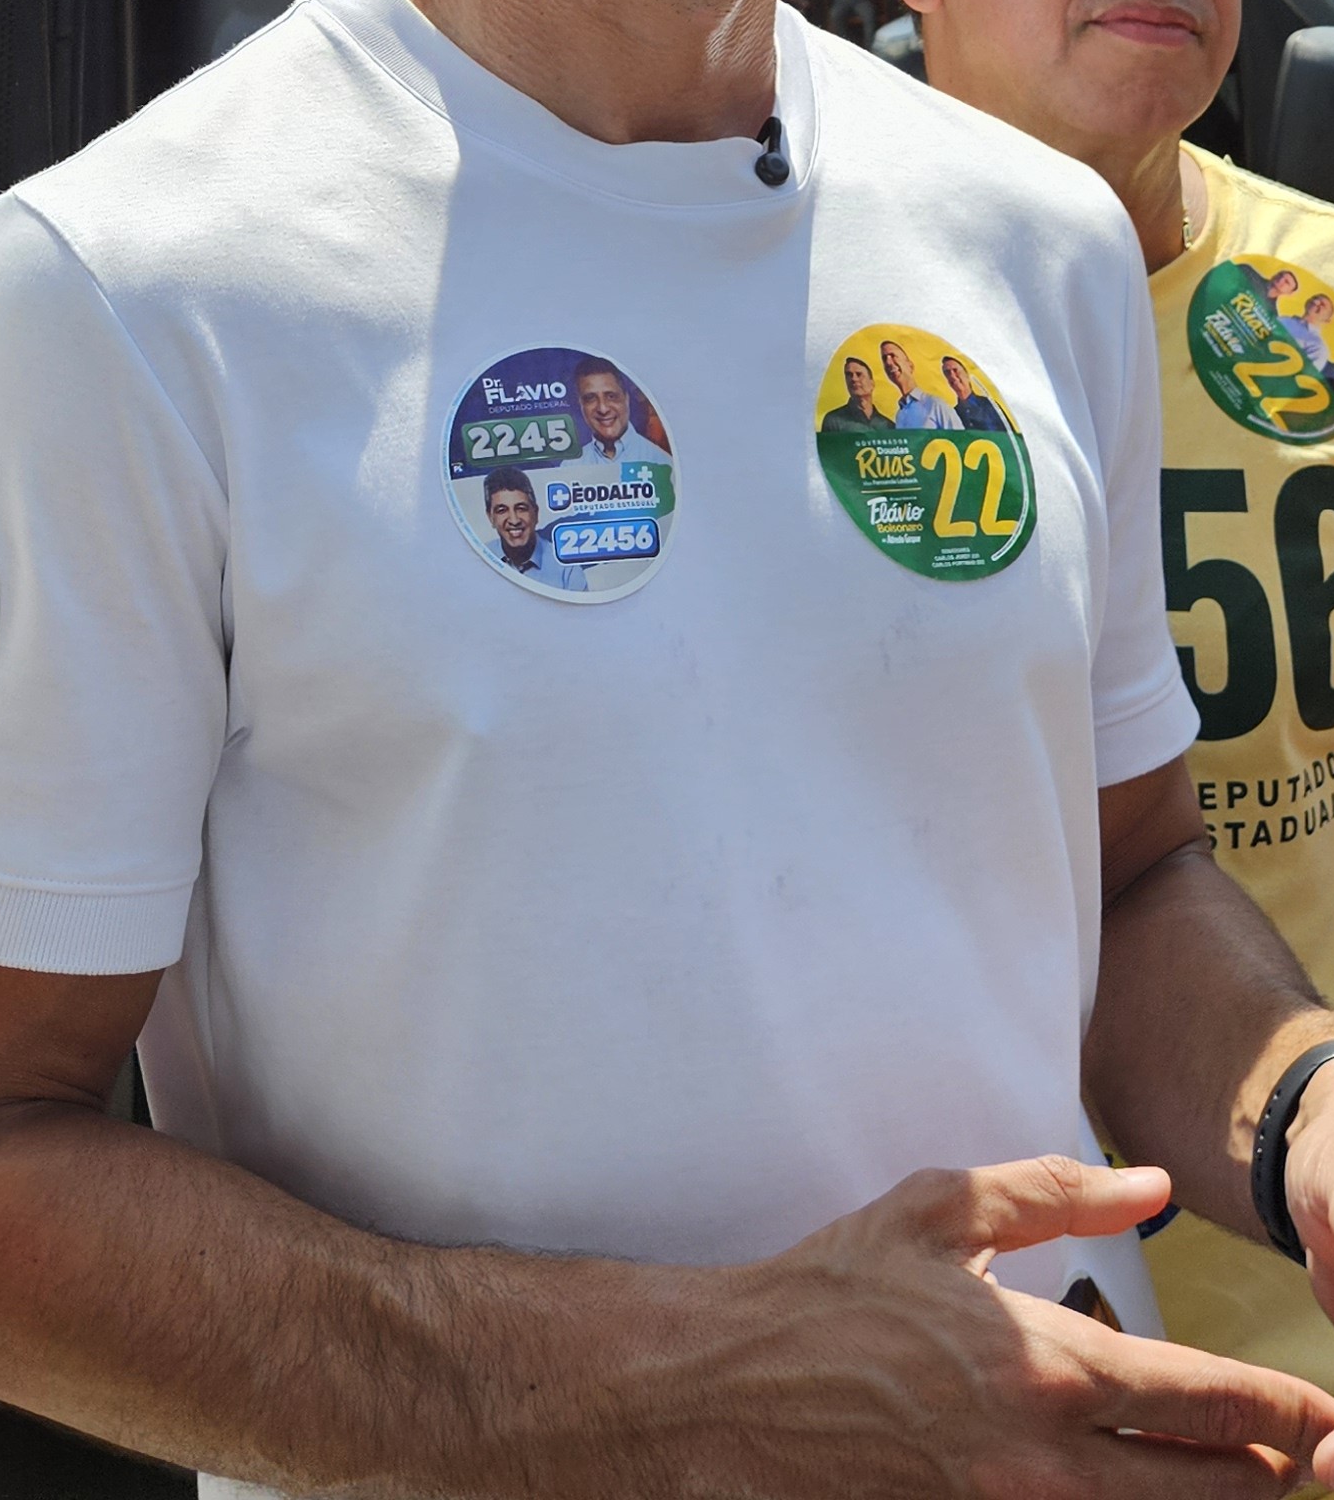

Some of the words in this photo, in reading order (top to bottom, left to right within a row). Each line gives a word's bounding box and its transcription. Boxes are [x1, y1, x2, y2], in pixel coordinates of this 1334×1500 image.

[482, 377, 503, 389] Dr.
[1233, 341, 1330, 431] 22
[488, 403, 532, 414] DEPUTADO
[468, 419, 572, 460] 2245
[855, 447, 916, 479] Ruas
[921, 438, 1020, 538] 22
[573, 503, 615, 512] DEPUTADO
[617, 500, 656, 509] ESTADUAL
[867, 496, 925, 525] Flávio
[560, 525, 654, 556] 22456
